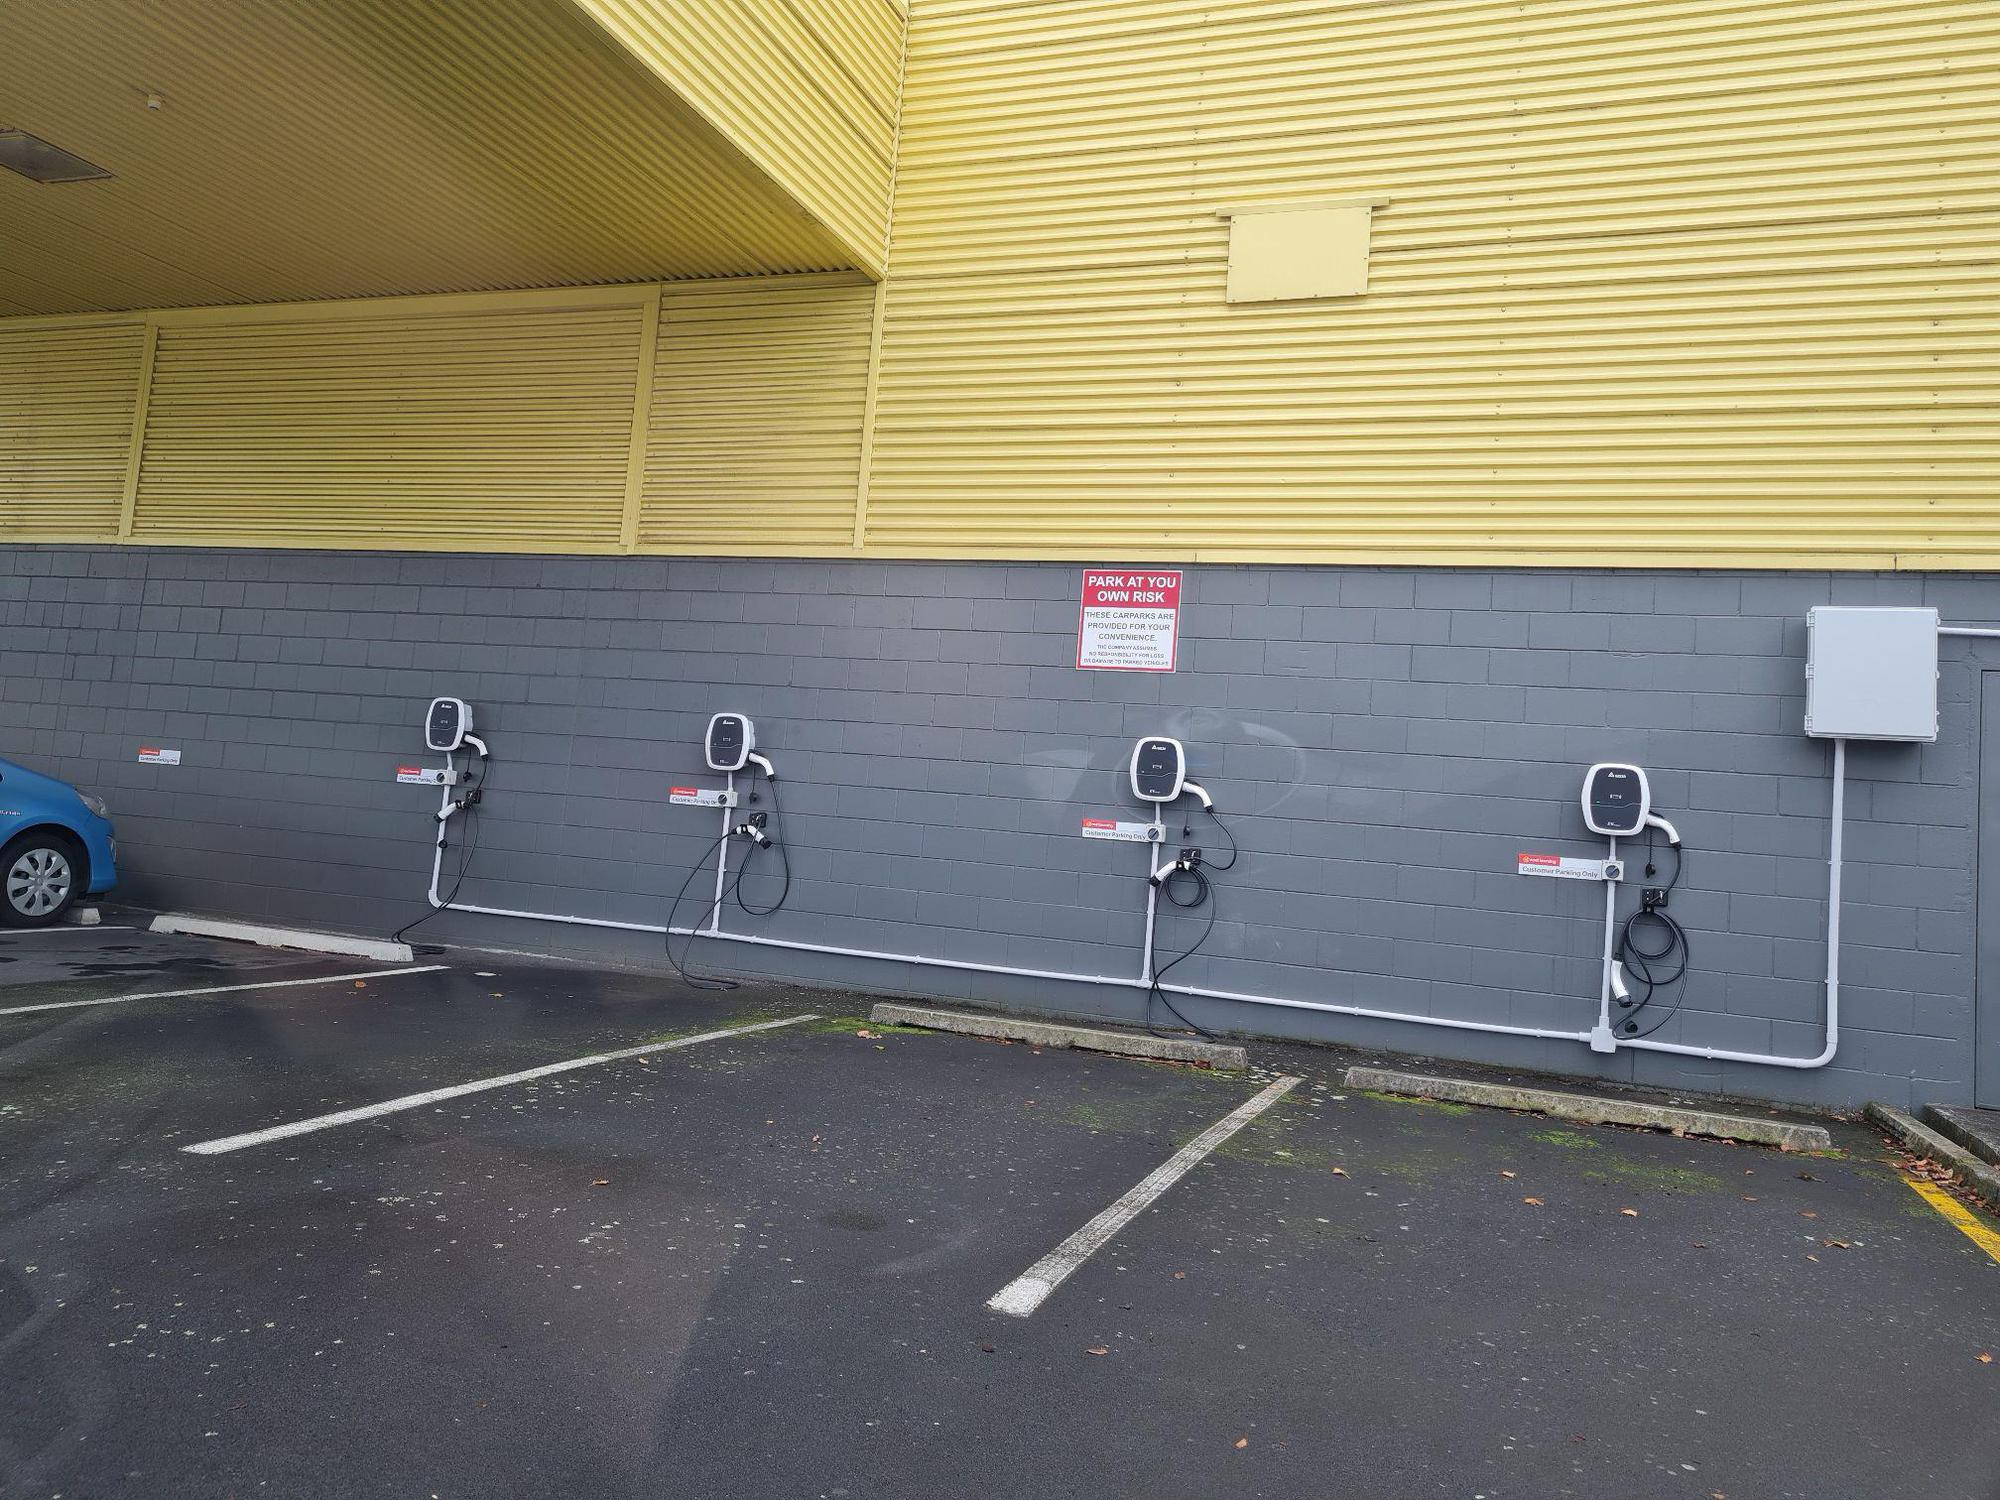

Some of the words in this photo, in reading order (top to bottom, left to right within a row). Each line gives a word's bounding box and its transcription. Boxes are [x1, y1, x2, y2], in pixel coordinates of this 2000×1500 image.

[1088, 576, 1125, 587] PARK
[1127, 576, 1145, 587] AT
[1147, 577, 1177, 588] YOU
[1097, 590, 1129, 602] OWN
[1133, 591, 1166, 603] RISK
[1086, 611, 1111, 619] THESE
[1113, 612, 1156, 620] CARPARKS
[1087, 622, 1128, 630] PROVIDED
[1129, 623, 1146, 631] FOR
[1098, 633, 1158, 642] CONVENIENCE.
[1522, 865, 1554, 874] Customer
[1555, 868, 1581, 878] Parking
[1581, 870, 1599, 879] Only
